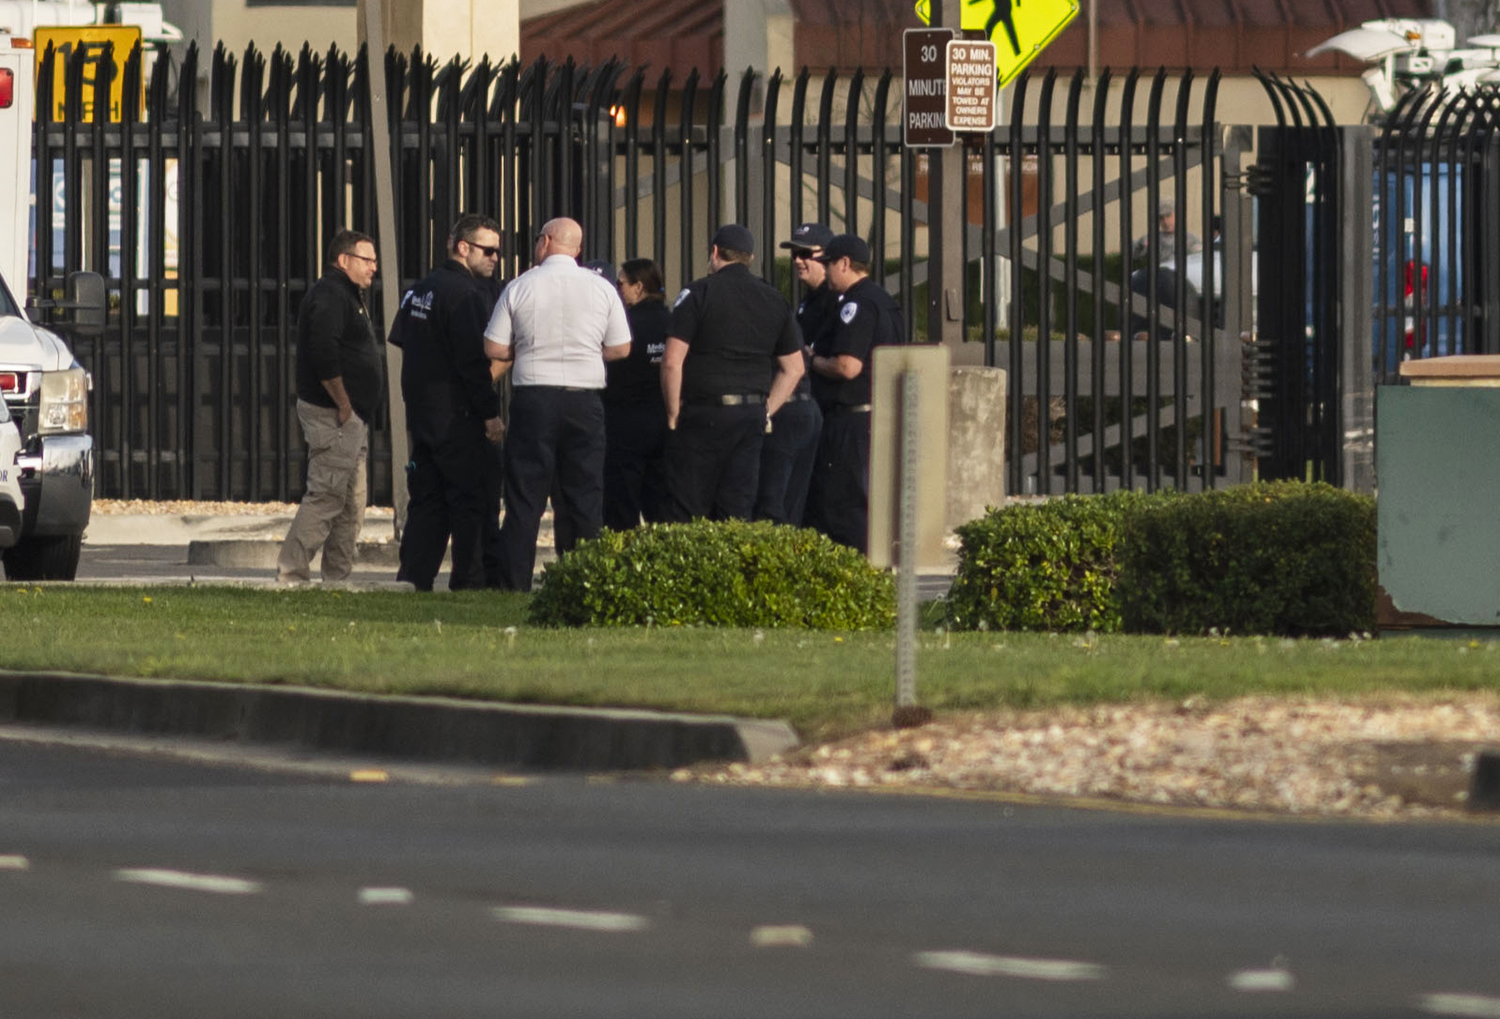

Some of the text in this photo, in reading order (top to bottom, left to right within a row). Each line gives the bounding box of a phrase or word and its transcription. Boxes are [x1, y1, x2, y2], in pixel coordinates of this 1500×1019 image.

[921, 45, 937, 62] 30
[952, 48, 991, 61] 30 MIN.
[58, 41, 118, 87] 15
[951, 63, 992, 76] PARKING
[952, 77, 990, 86] VIOLATORS
[957, 87, 985, 95] MAY BE
[952, 96, 989, 105] TOWED AT
[956, 106, 987, 115] OWNERS
[954, 116, 987, 125] EXPENSE
